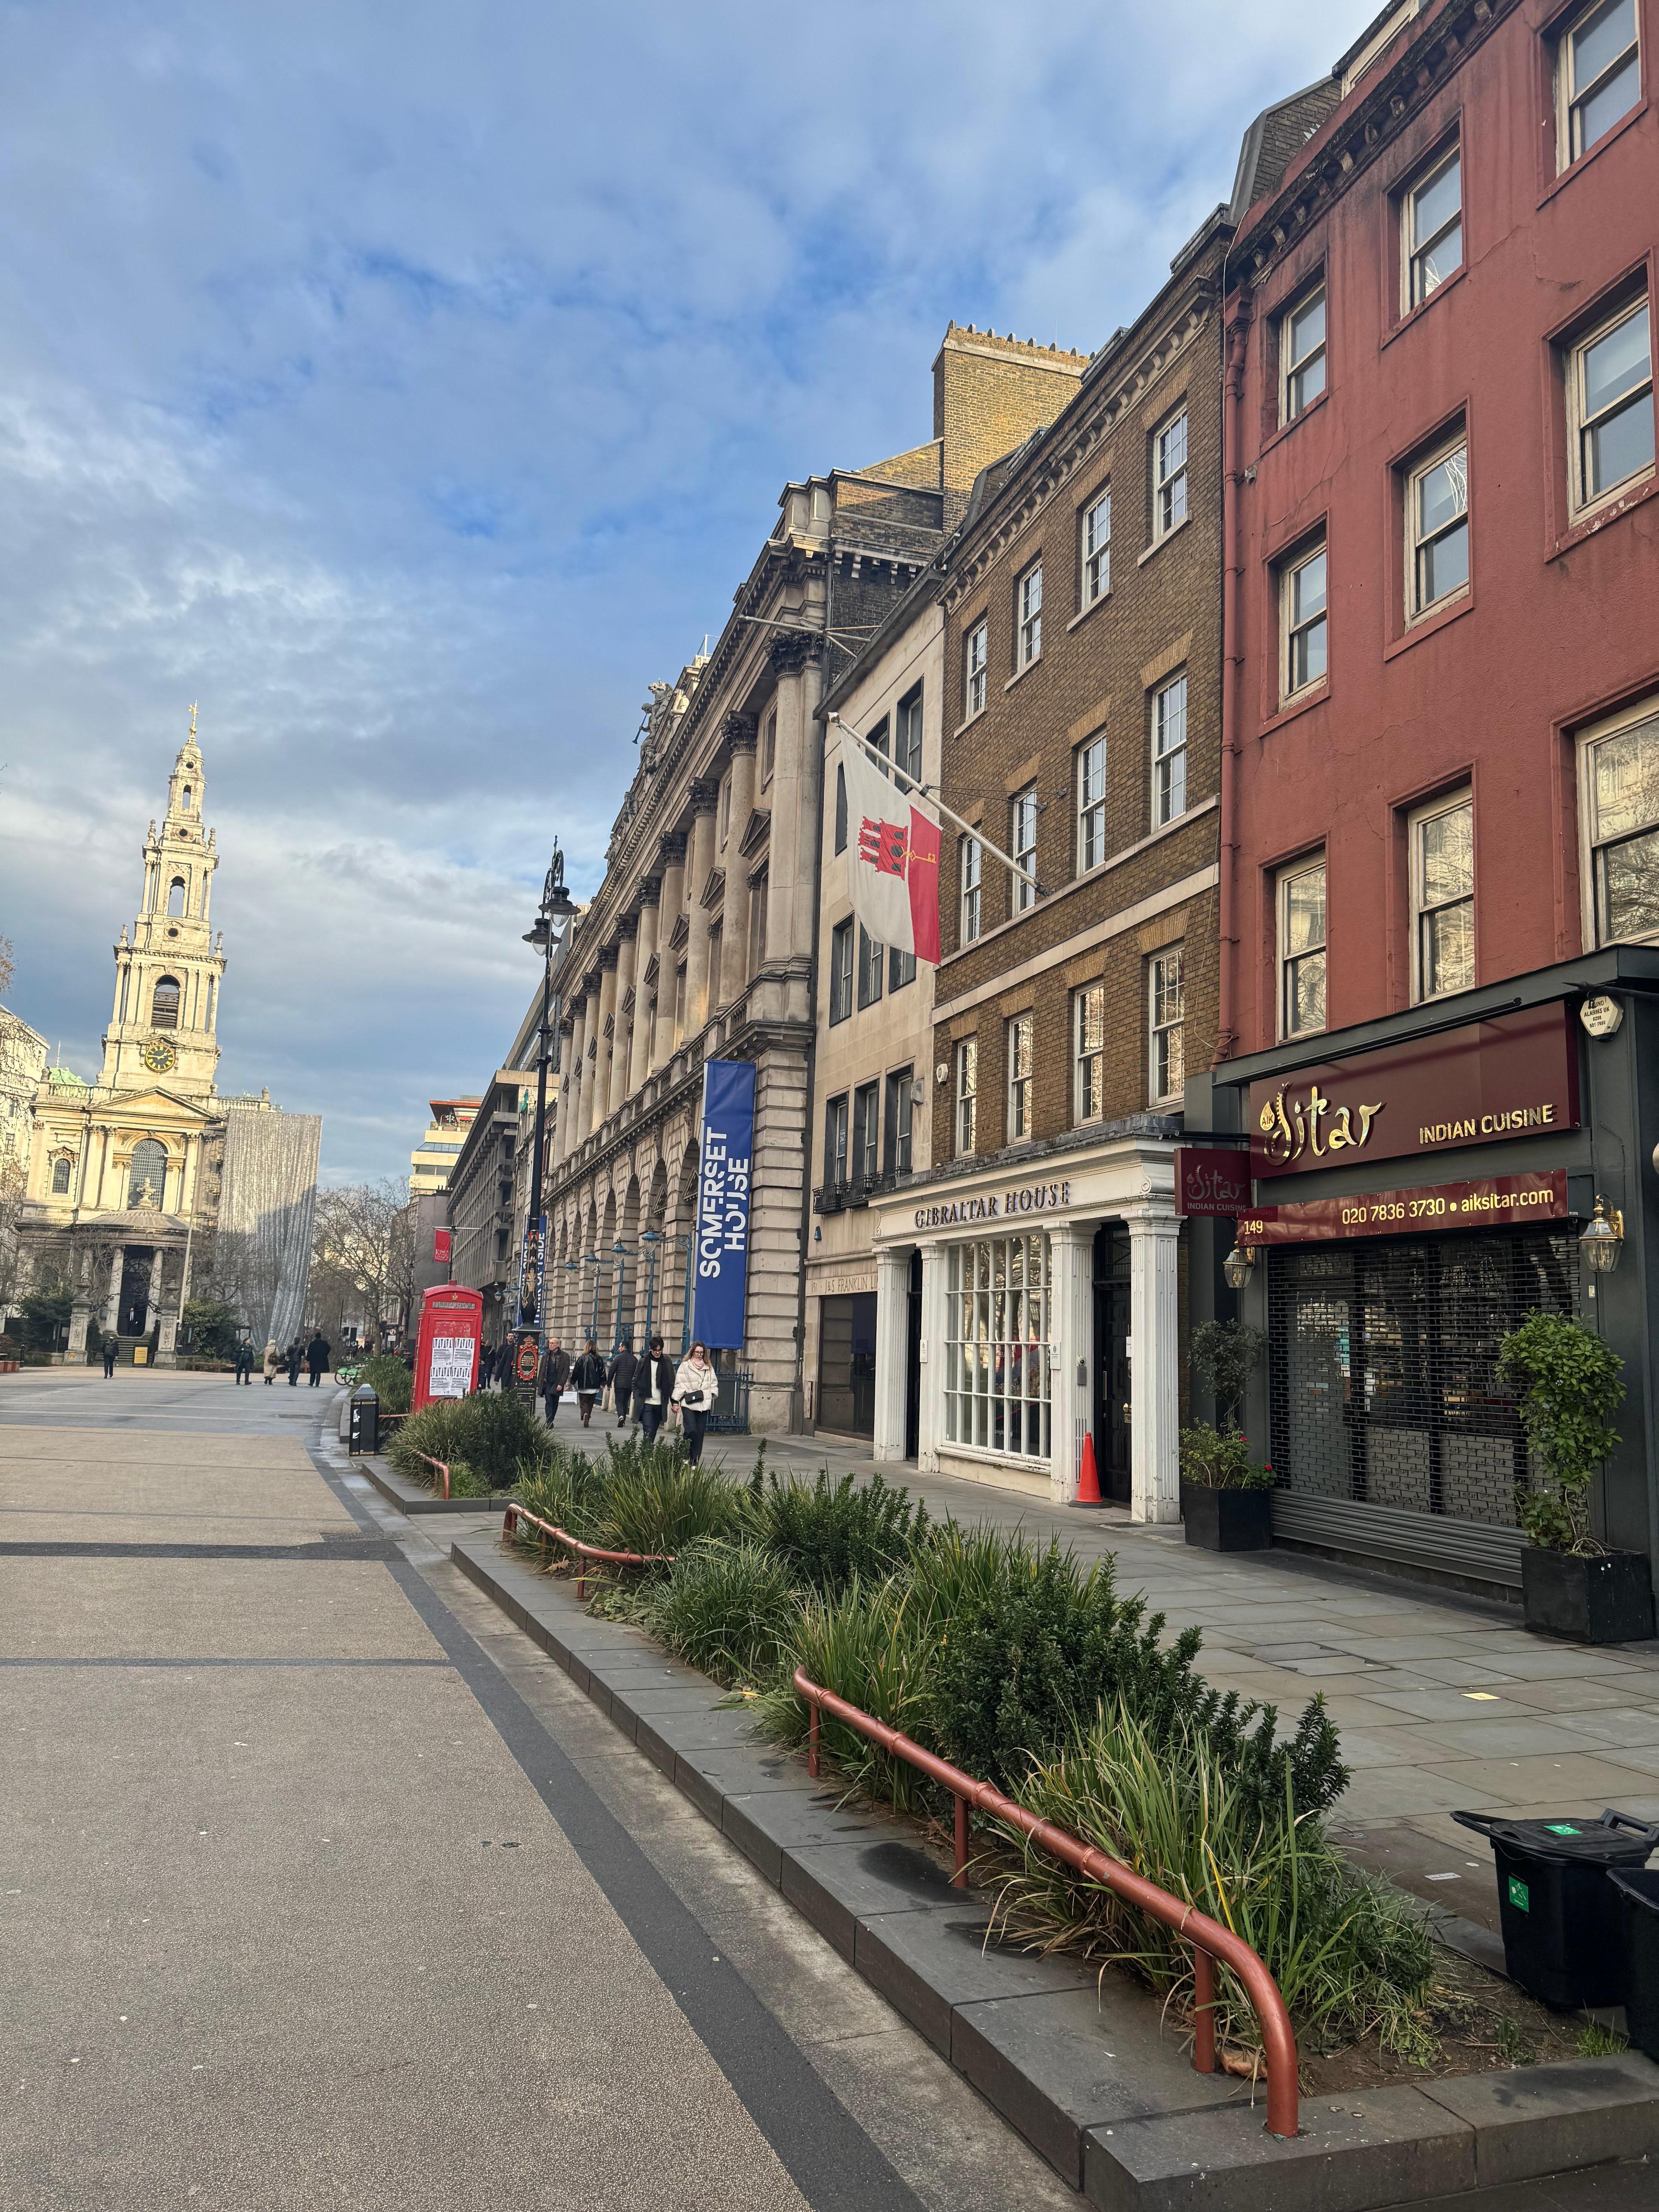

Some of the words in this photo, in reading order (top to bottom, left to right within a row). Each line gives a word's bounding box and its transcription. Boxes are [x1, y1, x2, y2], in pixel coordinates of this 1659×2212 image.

[1584, 1008, 1602, 1017] ALARMS
[1262, 1116, 1273, 1126] AIK
[1264, 1082, 1382, 1166] Sitar
[1420, 1119, 1475, 1144] INDIAN
[1481, 1104, 1554, 1133] CUISINE
[1187, 1164, 1246, 1200] Sitar
[699, 1127, 727, 1278] SOMERSET
[724, 1158, 749, 1250] HOUSE
[914, 1196, 998, 1228] GIBRALTAR
[1004, 1182, 1069, 1214] HOUSE
[1342, 1207, 1367, 1224] 020
[1370, 1202, 1405, 1221] 7836
[1409, 1198, 1445, 1217] 3730
[1461, 1189, 1554, 1212] aiksitar.com
[1244, 1220, 1263, 1235] 149
[825, 1279, 835, 1294] J&S
[838, 1276, 867, 1293] FRANKLIN
